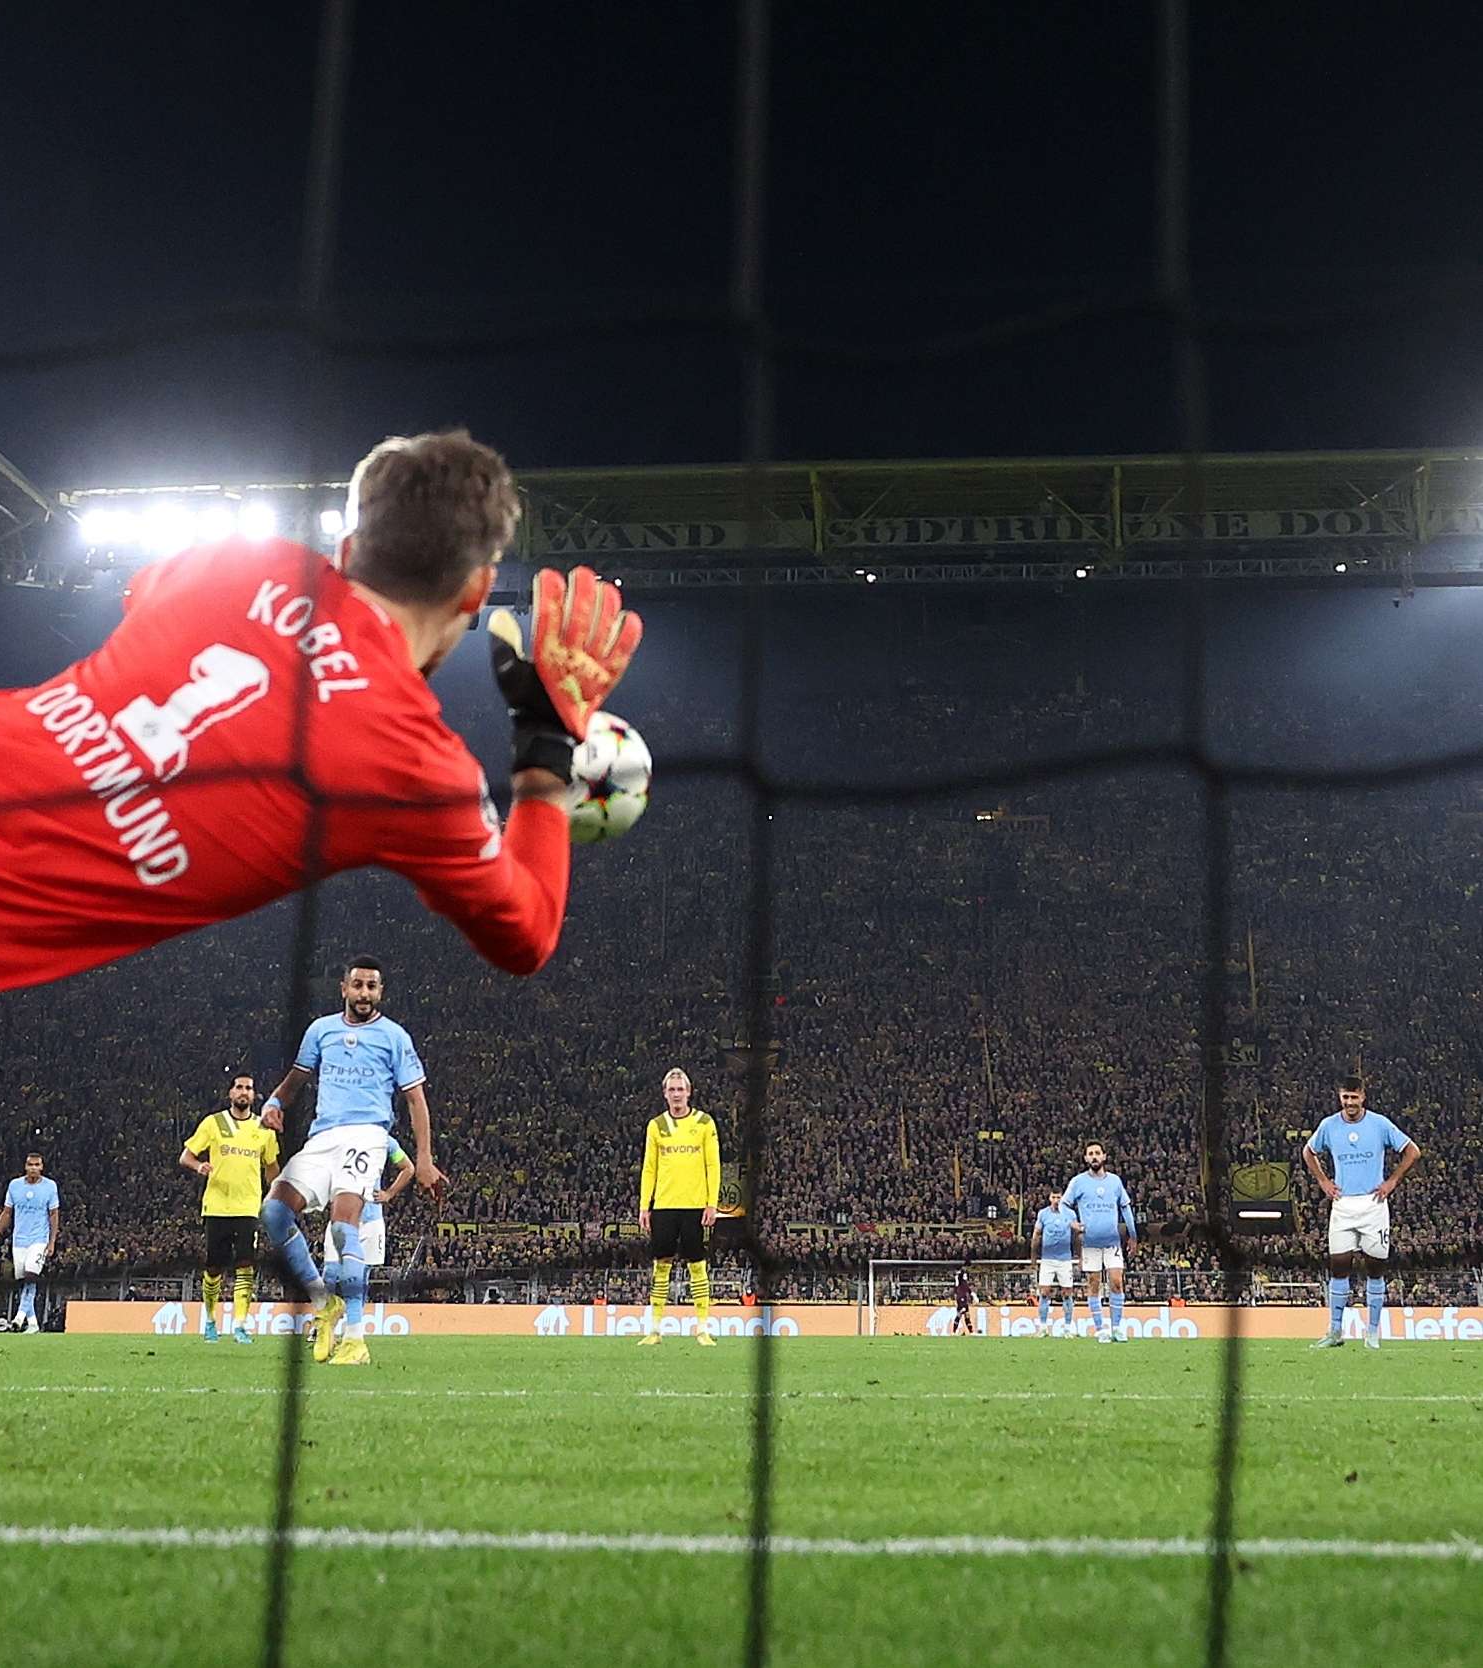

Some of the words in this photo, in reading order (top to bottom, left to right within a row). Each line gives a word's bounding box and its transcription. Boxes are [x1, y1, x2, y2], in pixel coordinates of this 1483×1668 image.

[543, 521, 726, 553] WAND
[246, 579, 370, 704] KOBEL
[111, 643, 271, 783] 1
[26, 682, 190, 886] DORTMUND
[342, 1148, 370, 1174] 26
[1378, 1228, 1390, 1246] 16
[199, 1302, 410, 1335] Lieferdo
[583, 1305, 799, 1336] Lieferando
